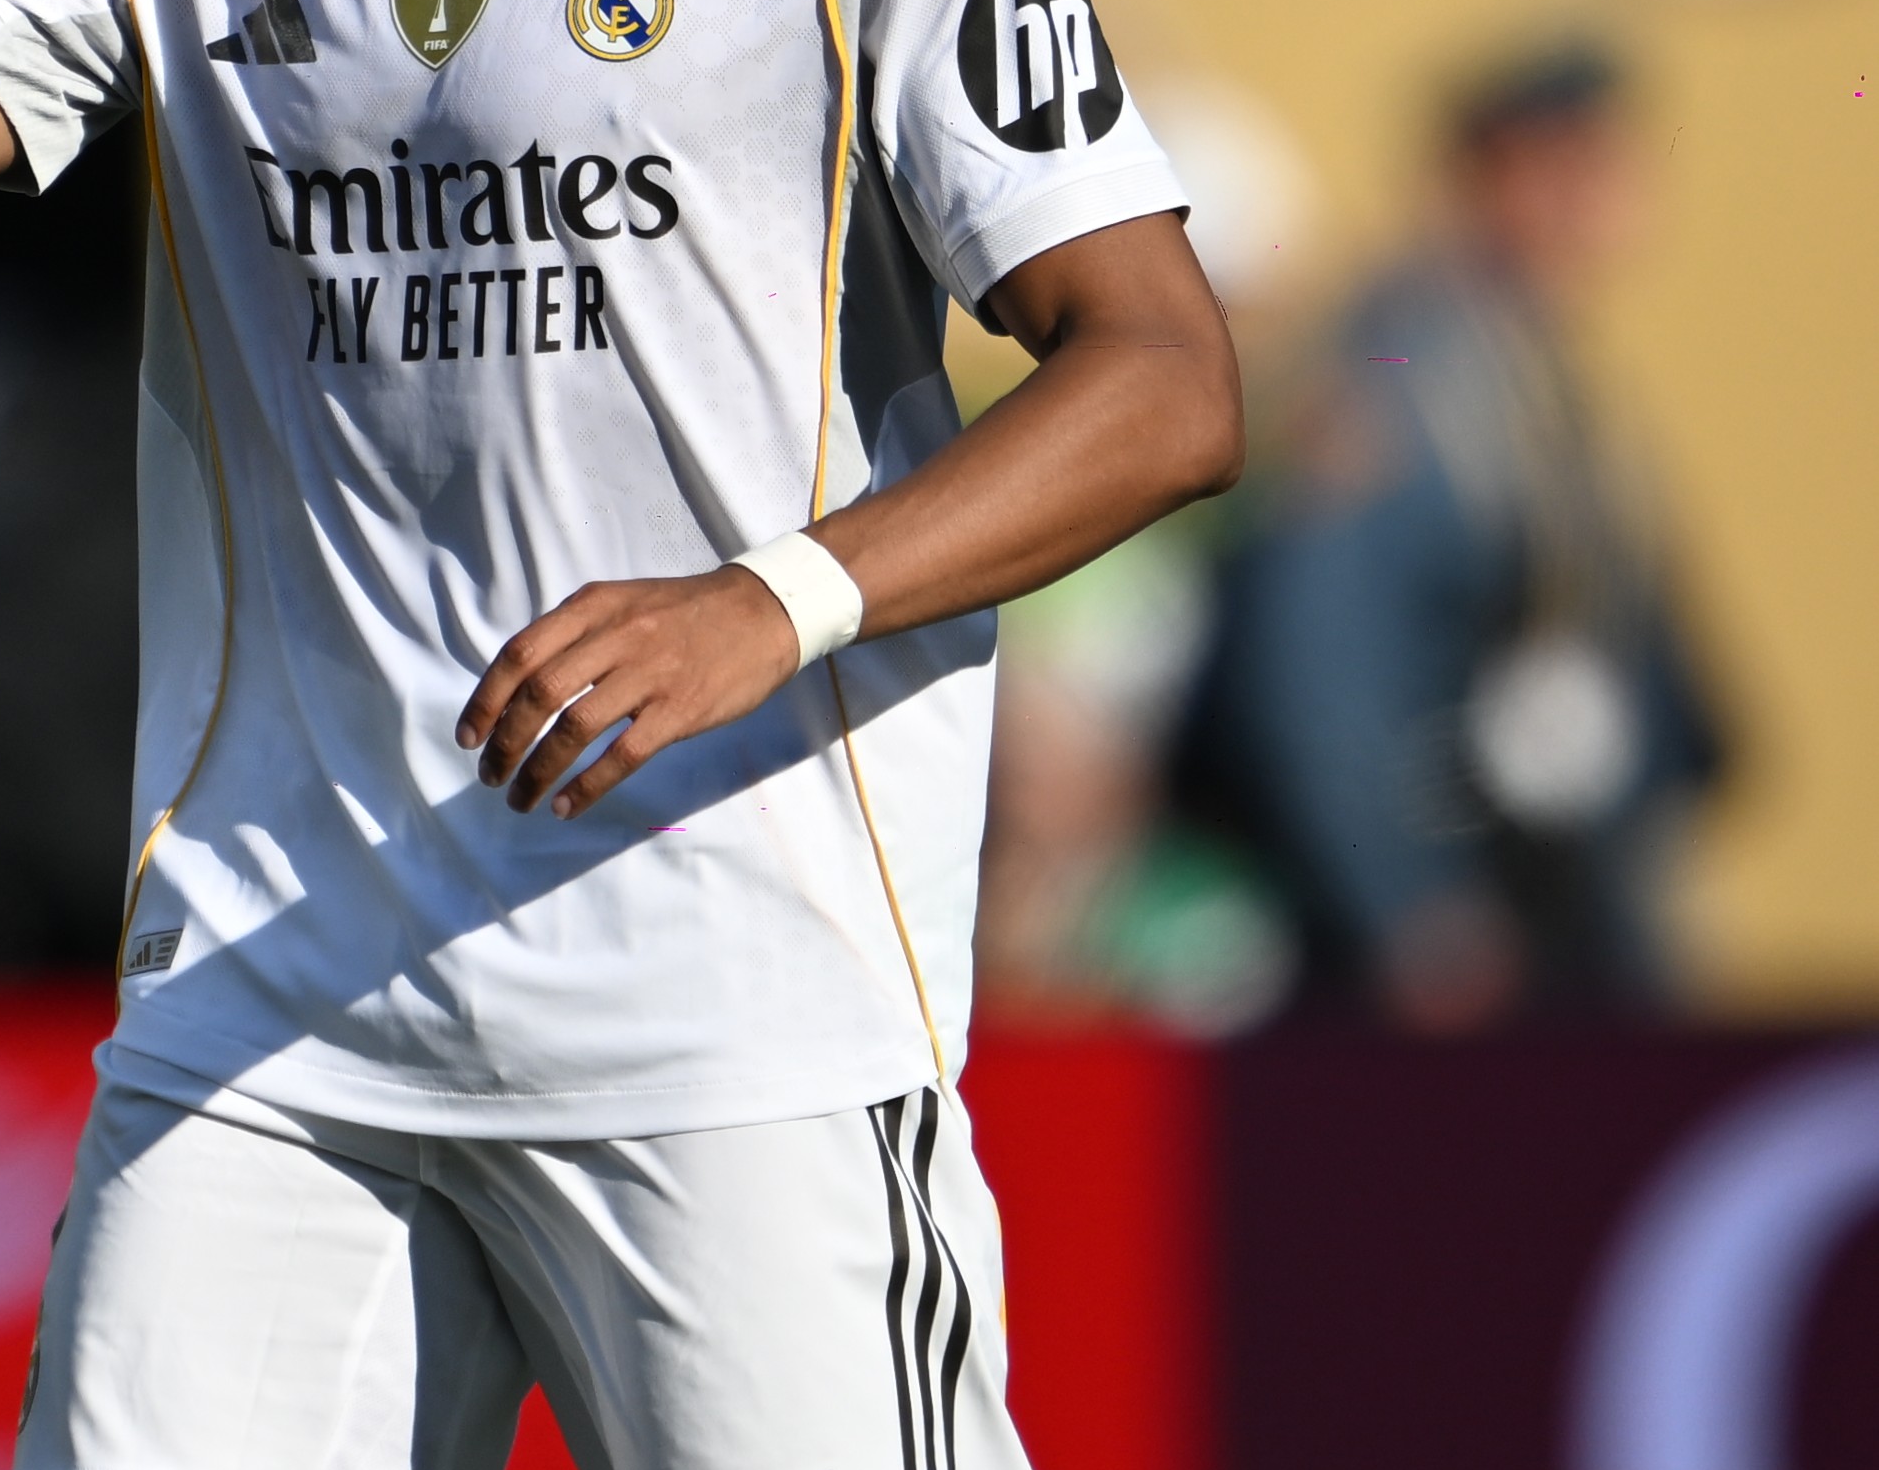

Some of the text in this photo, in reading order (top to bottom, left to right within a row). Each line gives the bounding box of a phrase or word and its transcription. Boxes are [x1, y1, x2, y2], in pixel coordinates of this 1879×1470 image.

[424, 39, 449, 51] FIFA
[244, 138, 679, 255] Emirates
[307, 266, 608, 364] FLY BETTER
